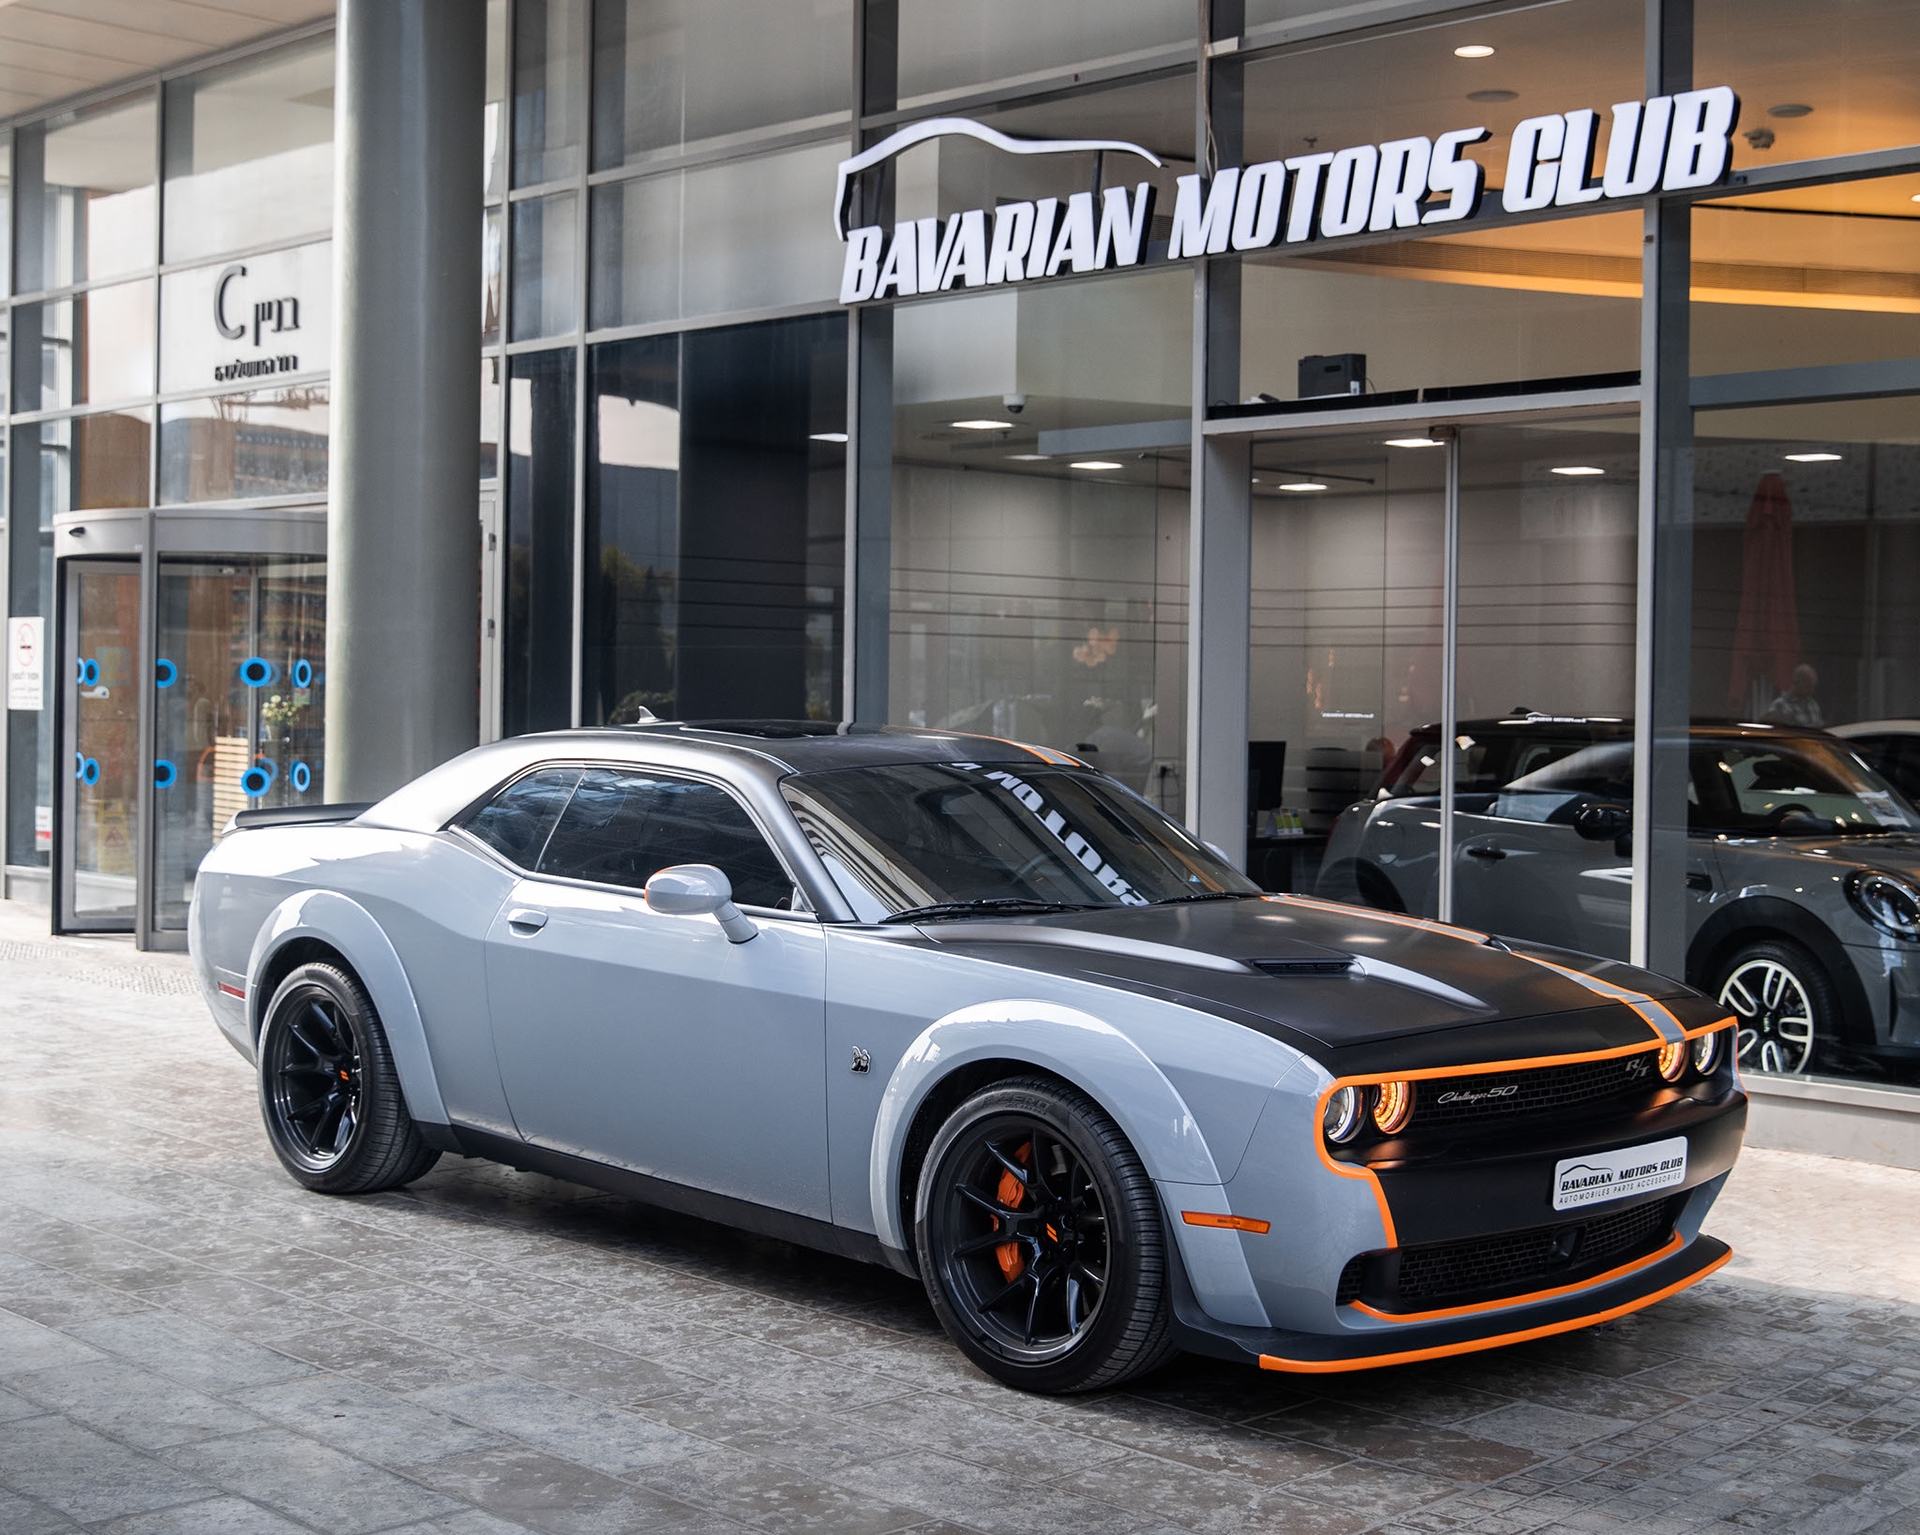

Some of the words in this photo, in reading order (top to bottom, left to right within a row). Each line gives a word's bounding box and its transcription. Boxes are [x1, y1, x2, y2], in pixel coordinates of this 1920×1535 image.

[840, 182, 1152, 305] BAVARIAN
[1167, 126, 1488, 260] MOTORS
[1502, 85, 1738, 214] CLUB
[214, 265, 247, 340] C
[1625, 1056, 1650, 1081] R/T
[1559, 1189, 1610, 1204] AUTOMOBILES
[1613, 1183, 1634, 1193] PARTS
[1637, 1171, 1681, 1188] ACCESSORIES
[1561, 1172, 1613, 1192] BAVARIAN
[1619, 1162, 1658, 1180] MOTORS
[1660, 1157, 1683, 1171] CLUB
